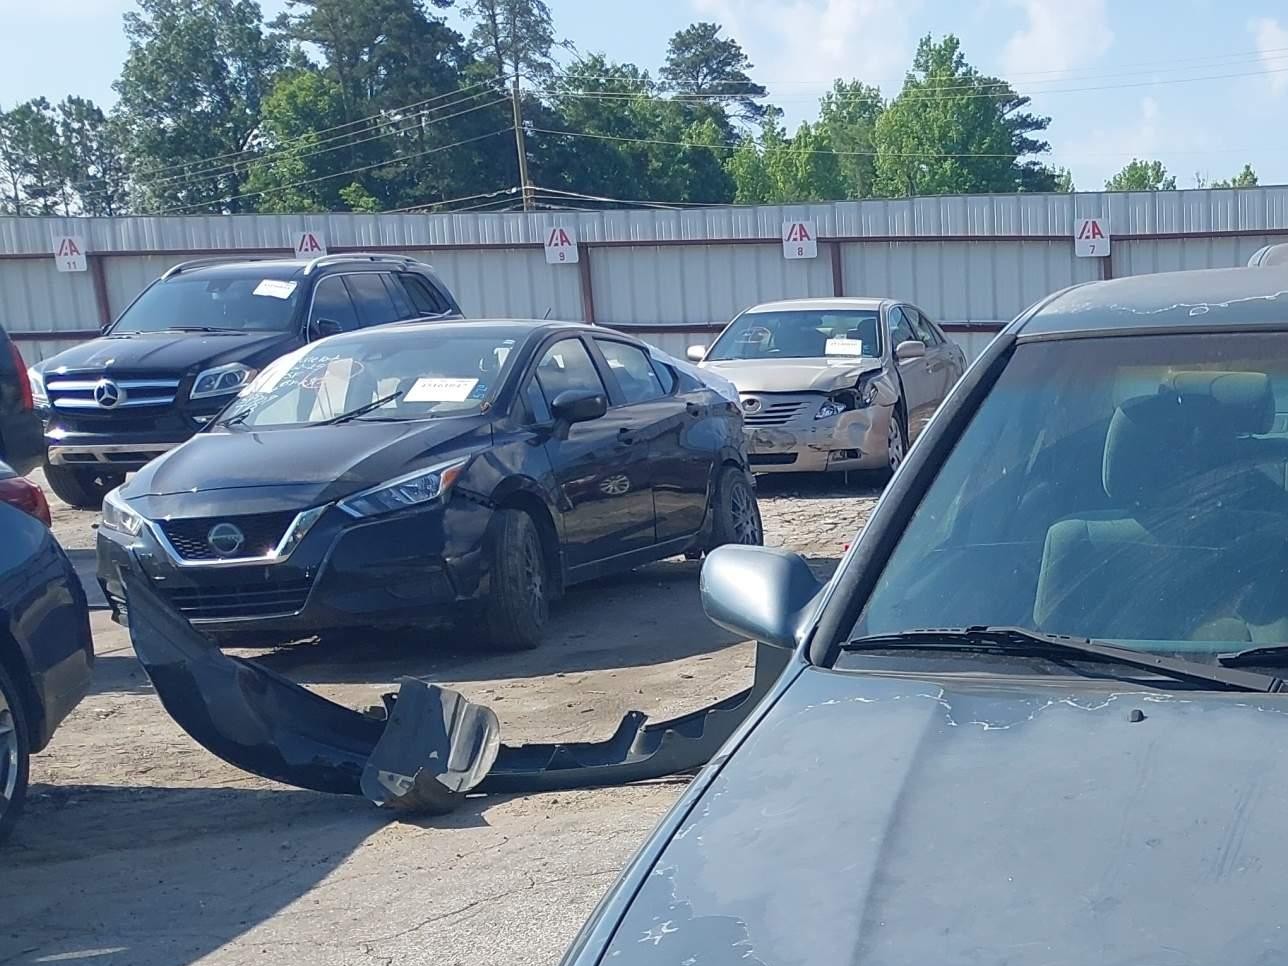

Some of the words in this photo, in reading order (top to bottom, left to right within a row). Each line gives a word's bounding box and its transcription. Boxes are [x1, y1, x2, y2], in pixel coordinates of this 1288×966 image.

[797, 247, 804, 256] 8
[1089, 244, 1096, 254] 7
[559, 252, 566, 261] 9
